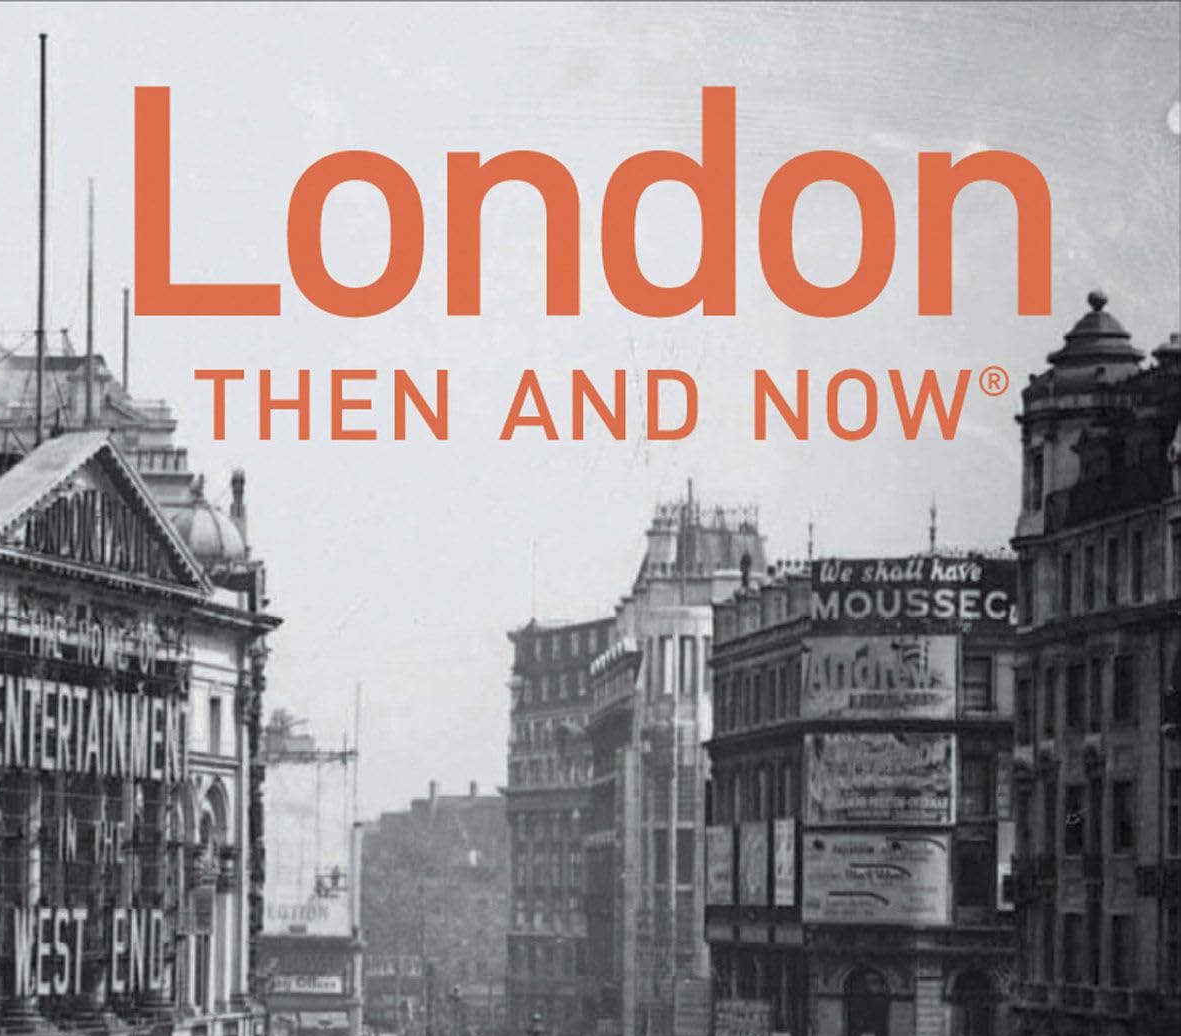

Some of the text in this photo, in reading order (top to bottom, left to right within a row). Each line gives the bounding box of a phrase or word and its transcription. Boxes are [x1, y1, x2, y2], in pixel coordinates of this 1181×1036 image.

[819, 560, 982, 584] We shall have
[811, 589, 1008, 621] MOUSSEC
[29, 611, 64, 659] THE
[77, 614, 130, 674] HOME
[58, 815, 125, 864] IN THE
[13, 908, 165, 996] WEST END
